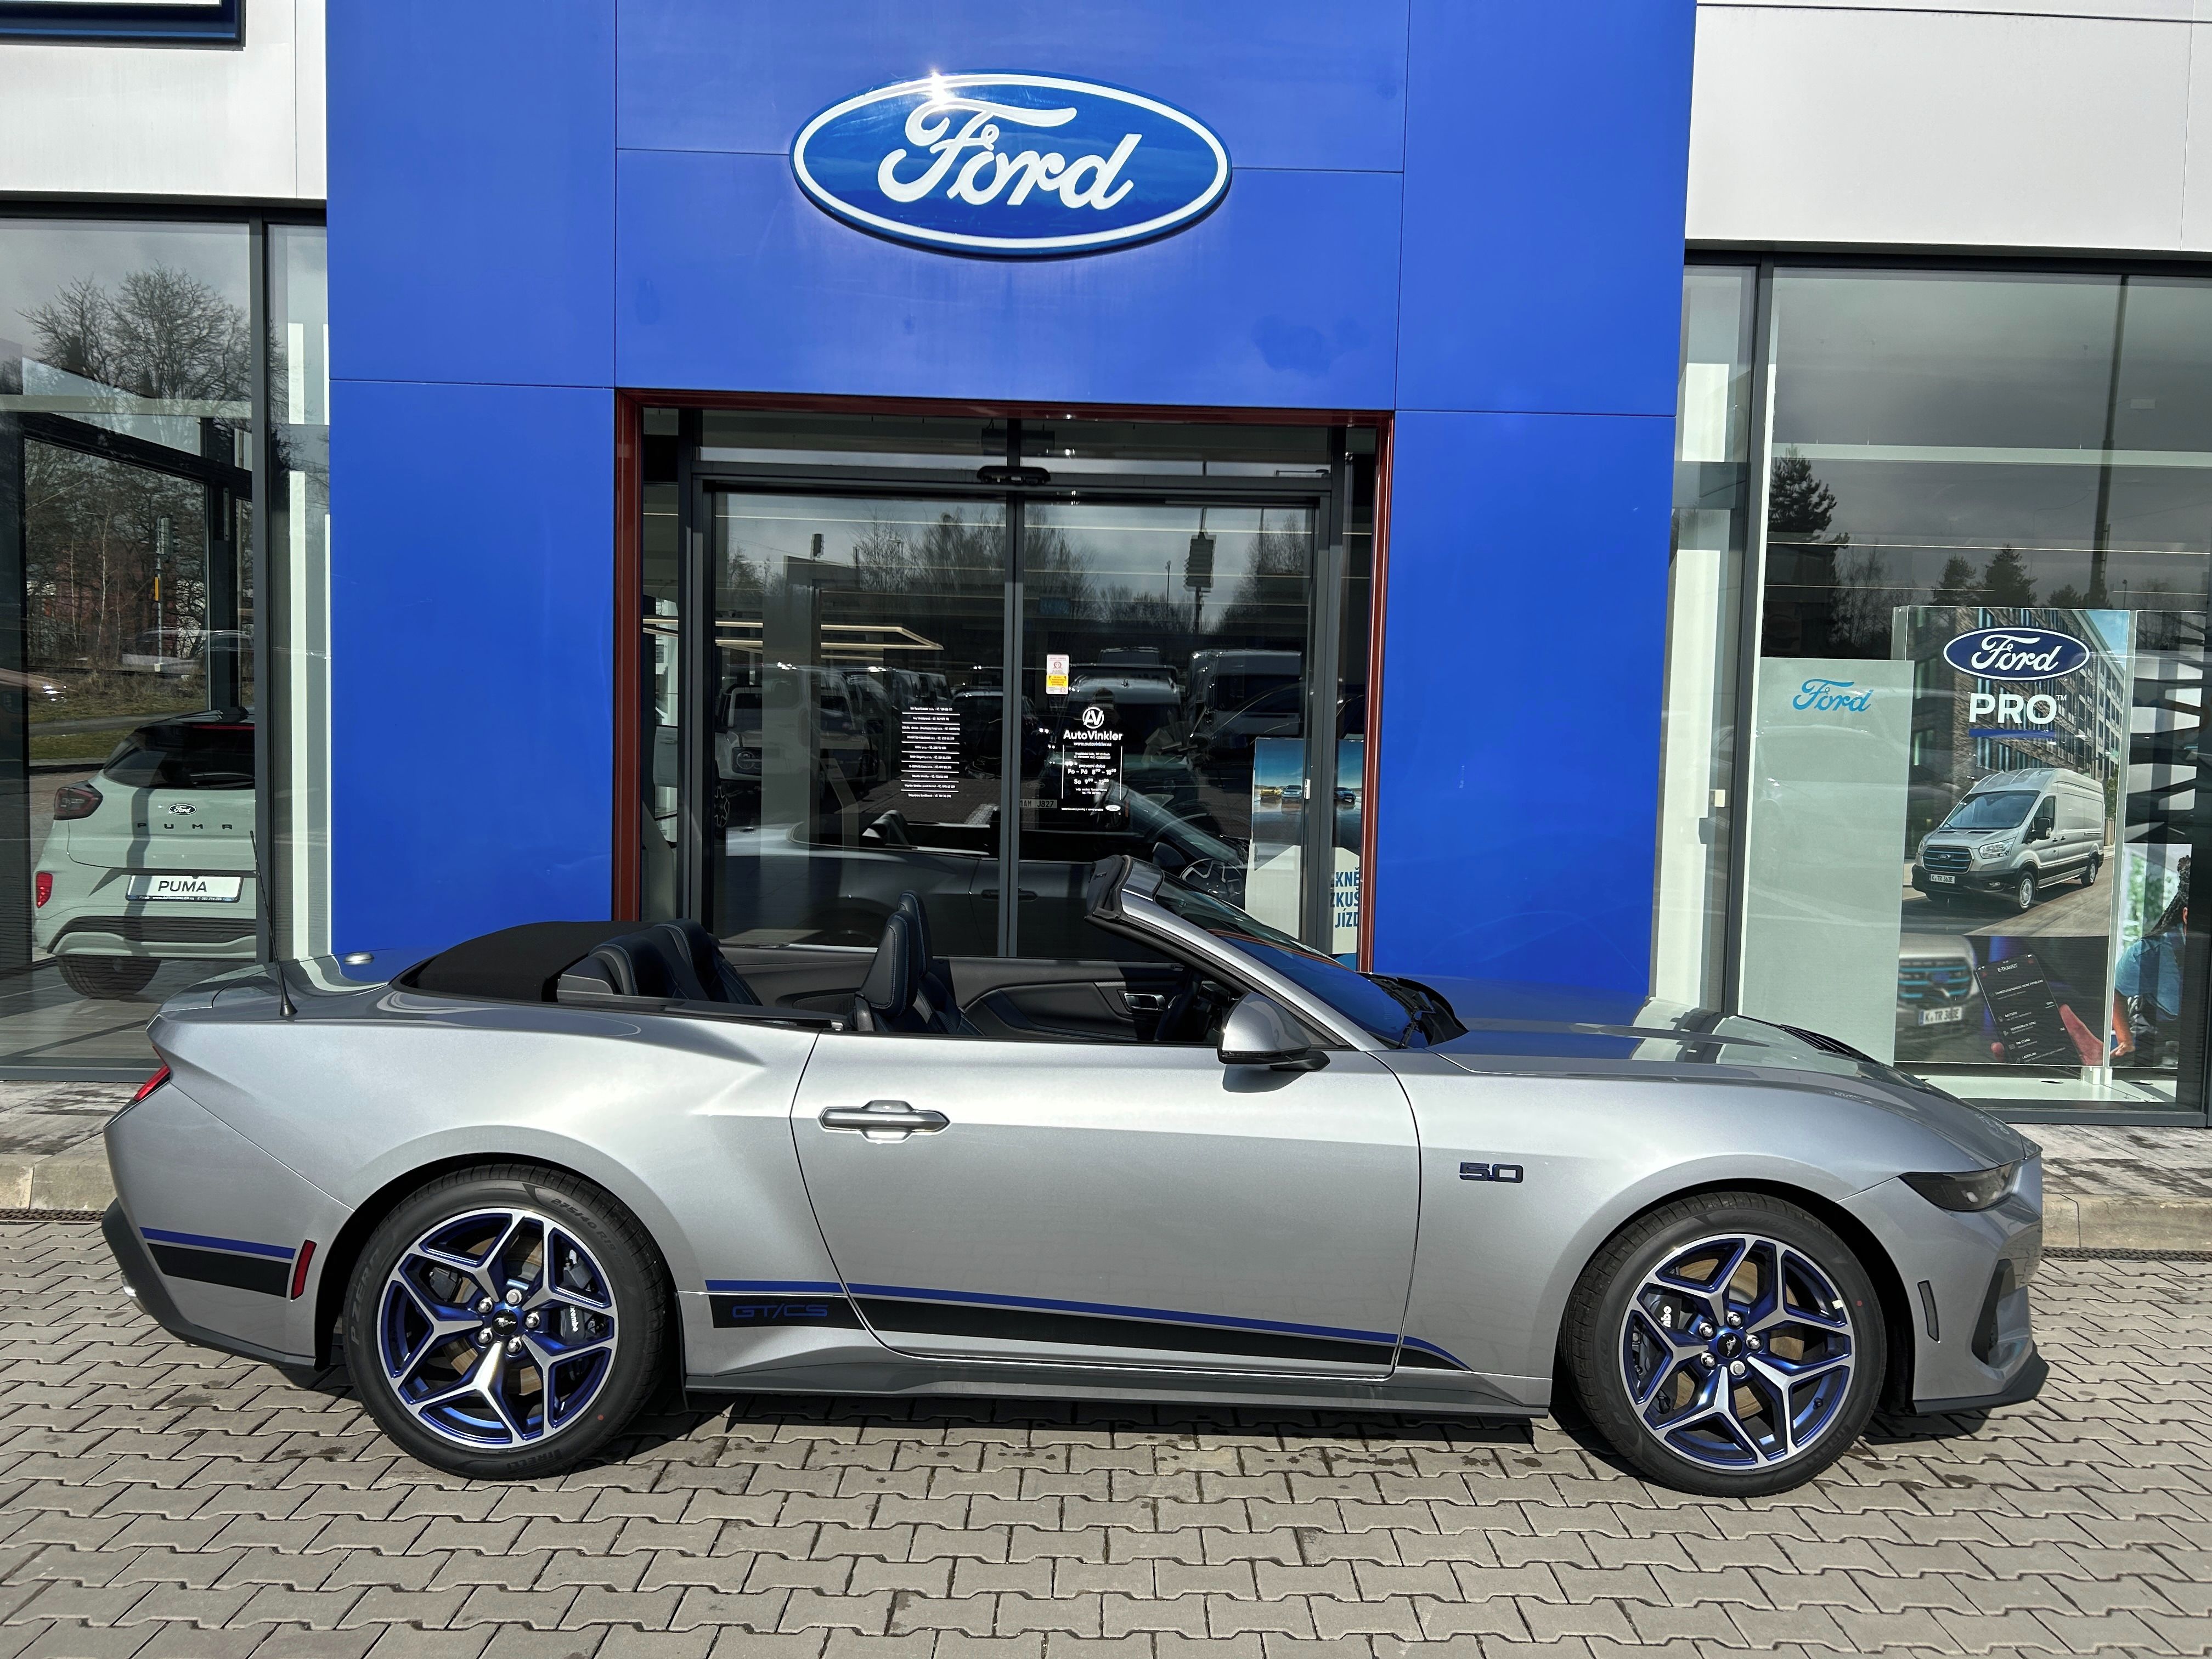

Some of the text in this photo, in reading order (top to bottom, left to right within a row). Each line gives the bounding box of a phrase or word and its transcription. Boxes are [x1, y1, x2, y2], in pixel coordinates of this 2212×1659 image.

[878, 97, 1142, 210] Ford
[1971, 634, 2062, 672] Ford
[1793, 679, 1874, 712] Ford
[1969, 693, 2057, 724] PRO
[1063, 730, 1123, 741] AutoVinkler
[158, 881, 207, 892] PUMA
[1459, 1161, 1523, 1183] 5.0
[732, 1303, 829, 1319] GT/CS
